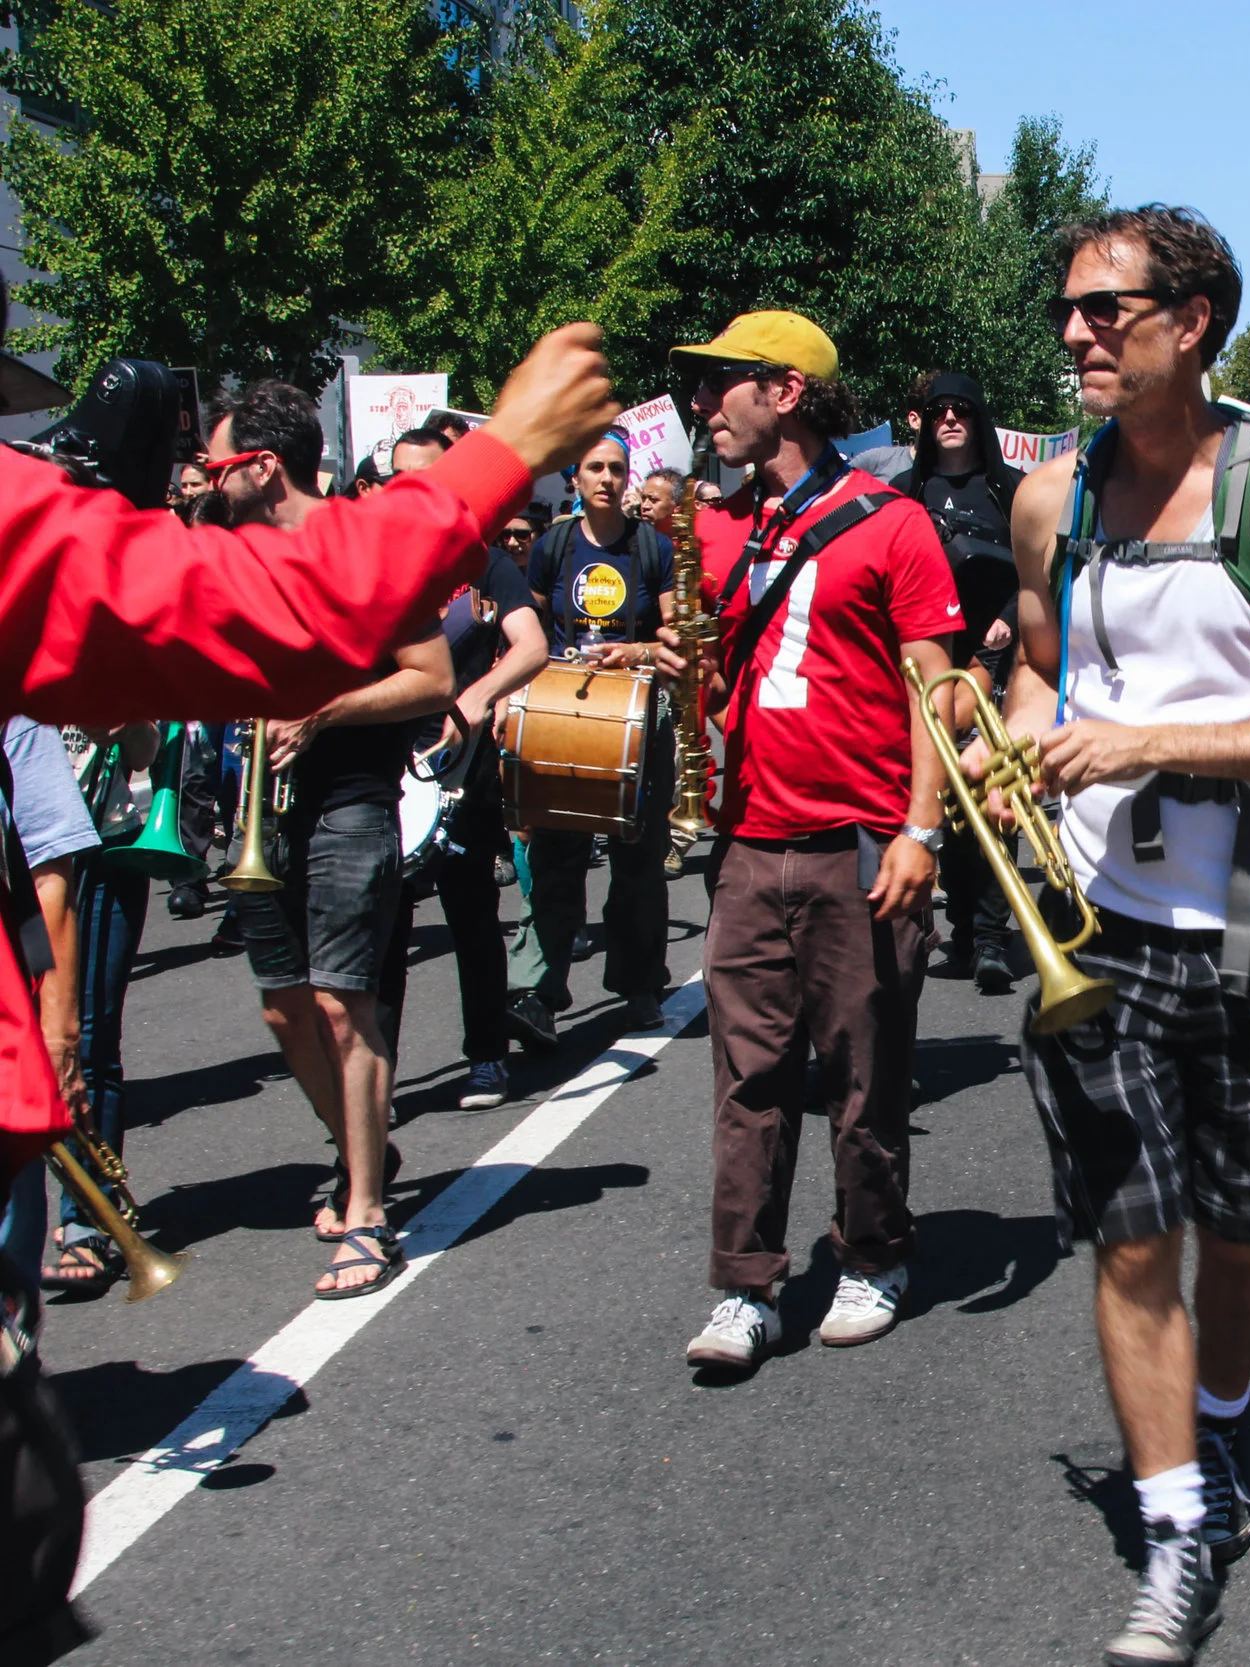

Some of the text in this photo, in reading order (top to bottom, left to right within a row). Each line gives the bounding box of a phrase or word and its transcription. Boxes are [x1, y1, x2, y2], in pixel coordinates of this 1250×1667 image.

[369, 405, 389, 413] STOP
[632, 400, 674, 423] WRONG
[579, 574, 622, 586] Berkeley's
[578, 586, 617, 596] FINEST
[577, 595, 616, 606] Teachers
